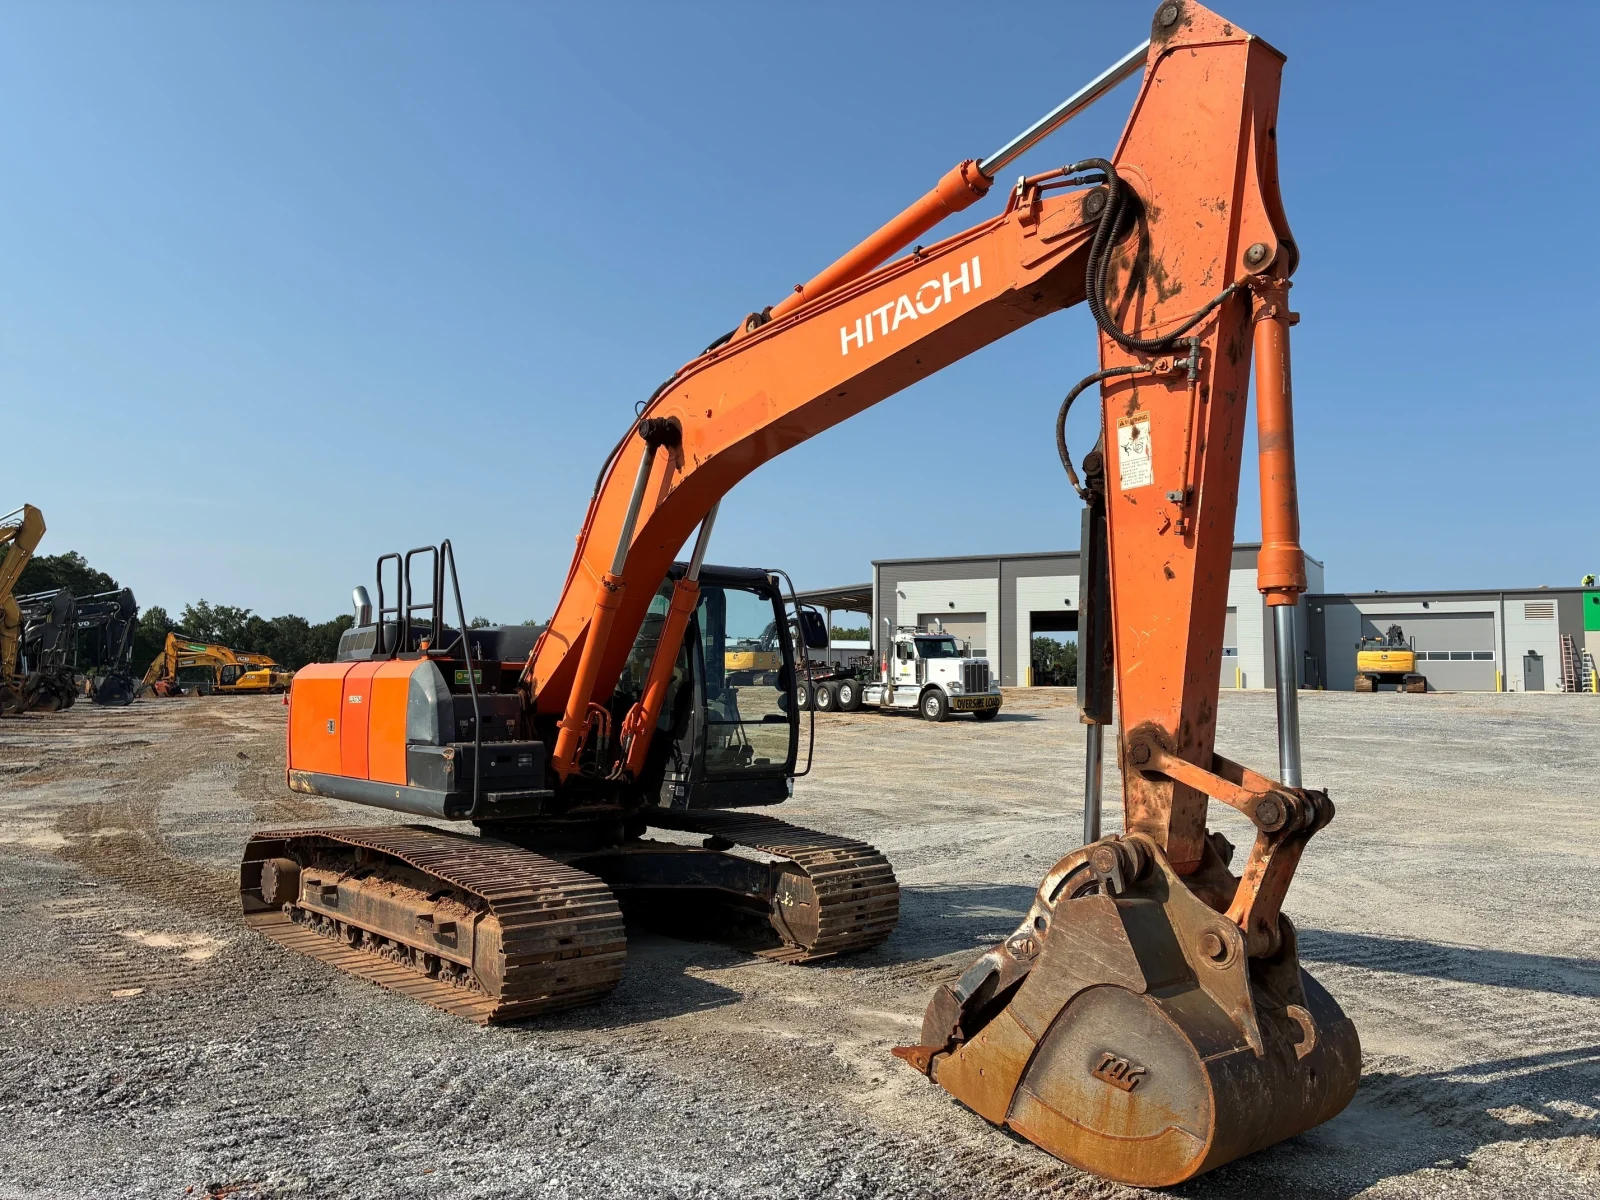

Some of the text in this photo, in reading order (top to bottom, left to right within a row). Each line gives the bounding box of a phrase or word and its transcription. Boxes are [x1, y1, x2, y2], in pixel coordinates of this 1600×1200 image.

[840, 256, 982, 356] HITACHI
[1125, 415, 1148, 425] WRNING
[957, 697, 1000, 709] OVERSIZE LOAD
